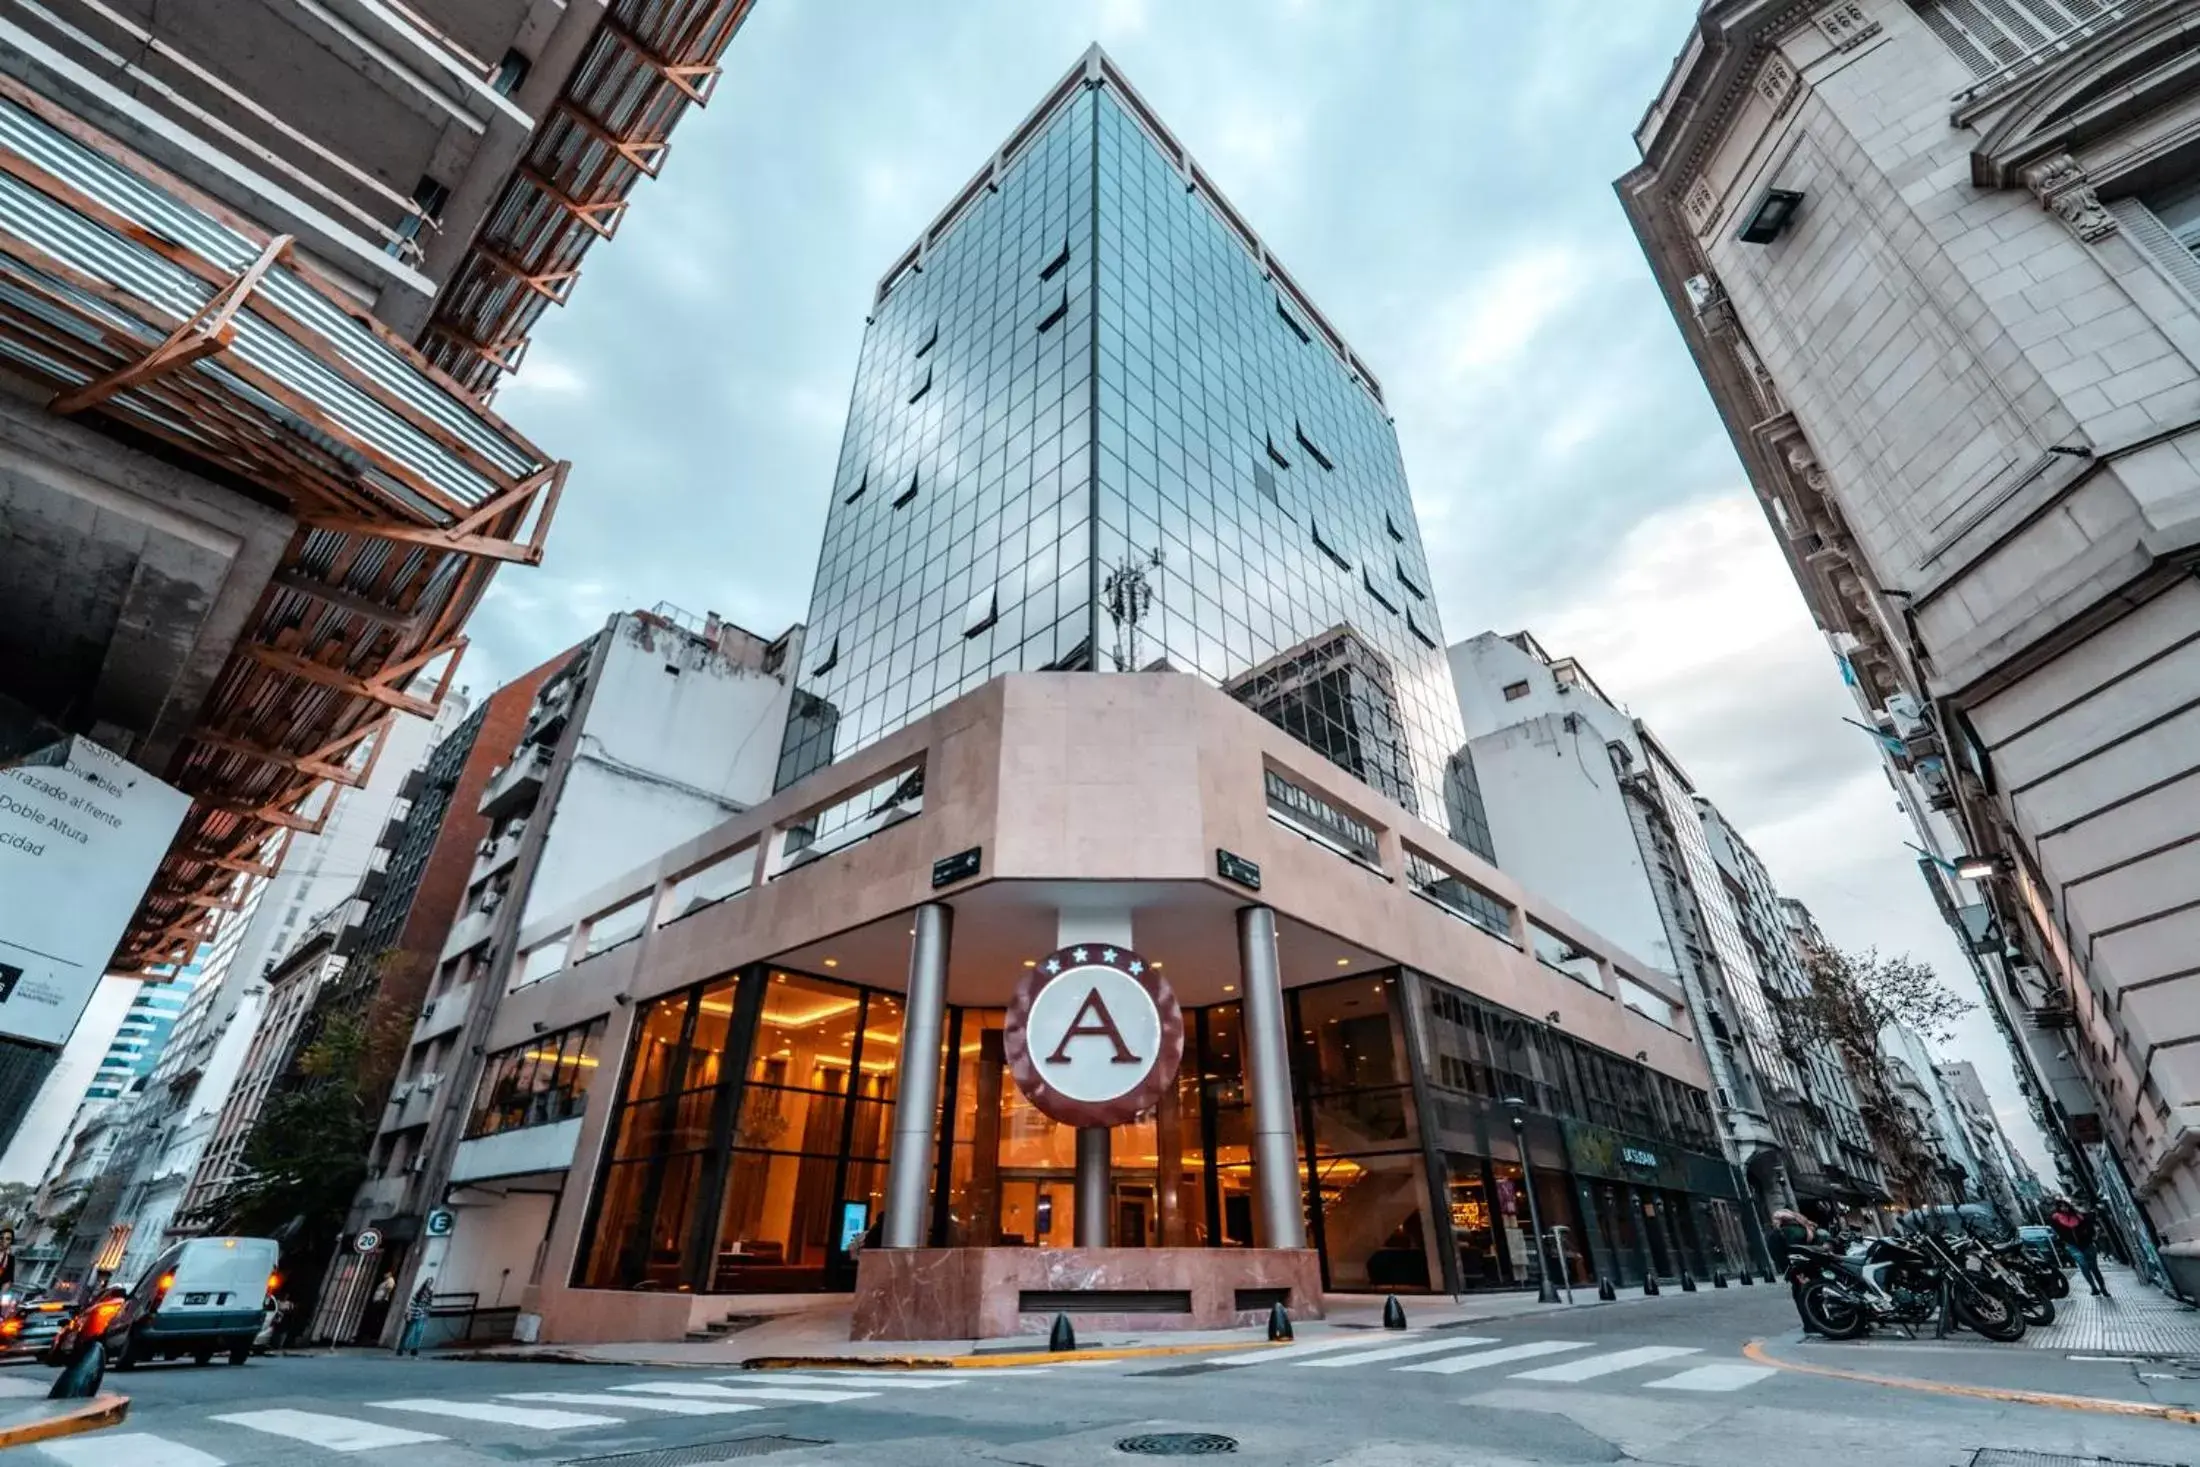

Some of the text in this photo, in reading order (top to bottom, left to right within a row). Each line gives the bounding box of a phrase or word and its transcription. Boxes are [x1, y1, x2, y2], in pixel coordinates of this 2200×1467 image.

[0, 794, 88, 844] Doble Altura
[83, 801, 122, 829] frente
[1045, 986, 1142, 1064] A
[434, 1215, 448, 1229] E
[360, 1235, 376, 1246] 20
